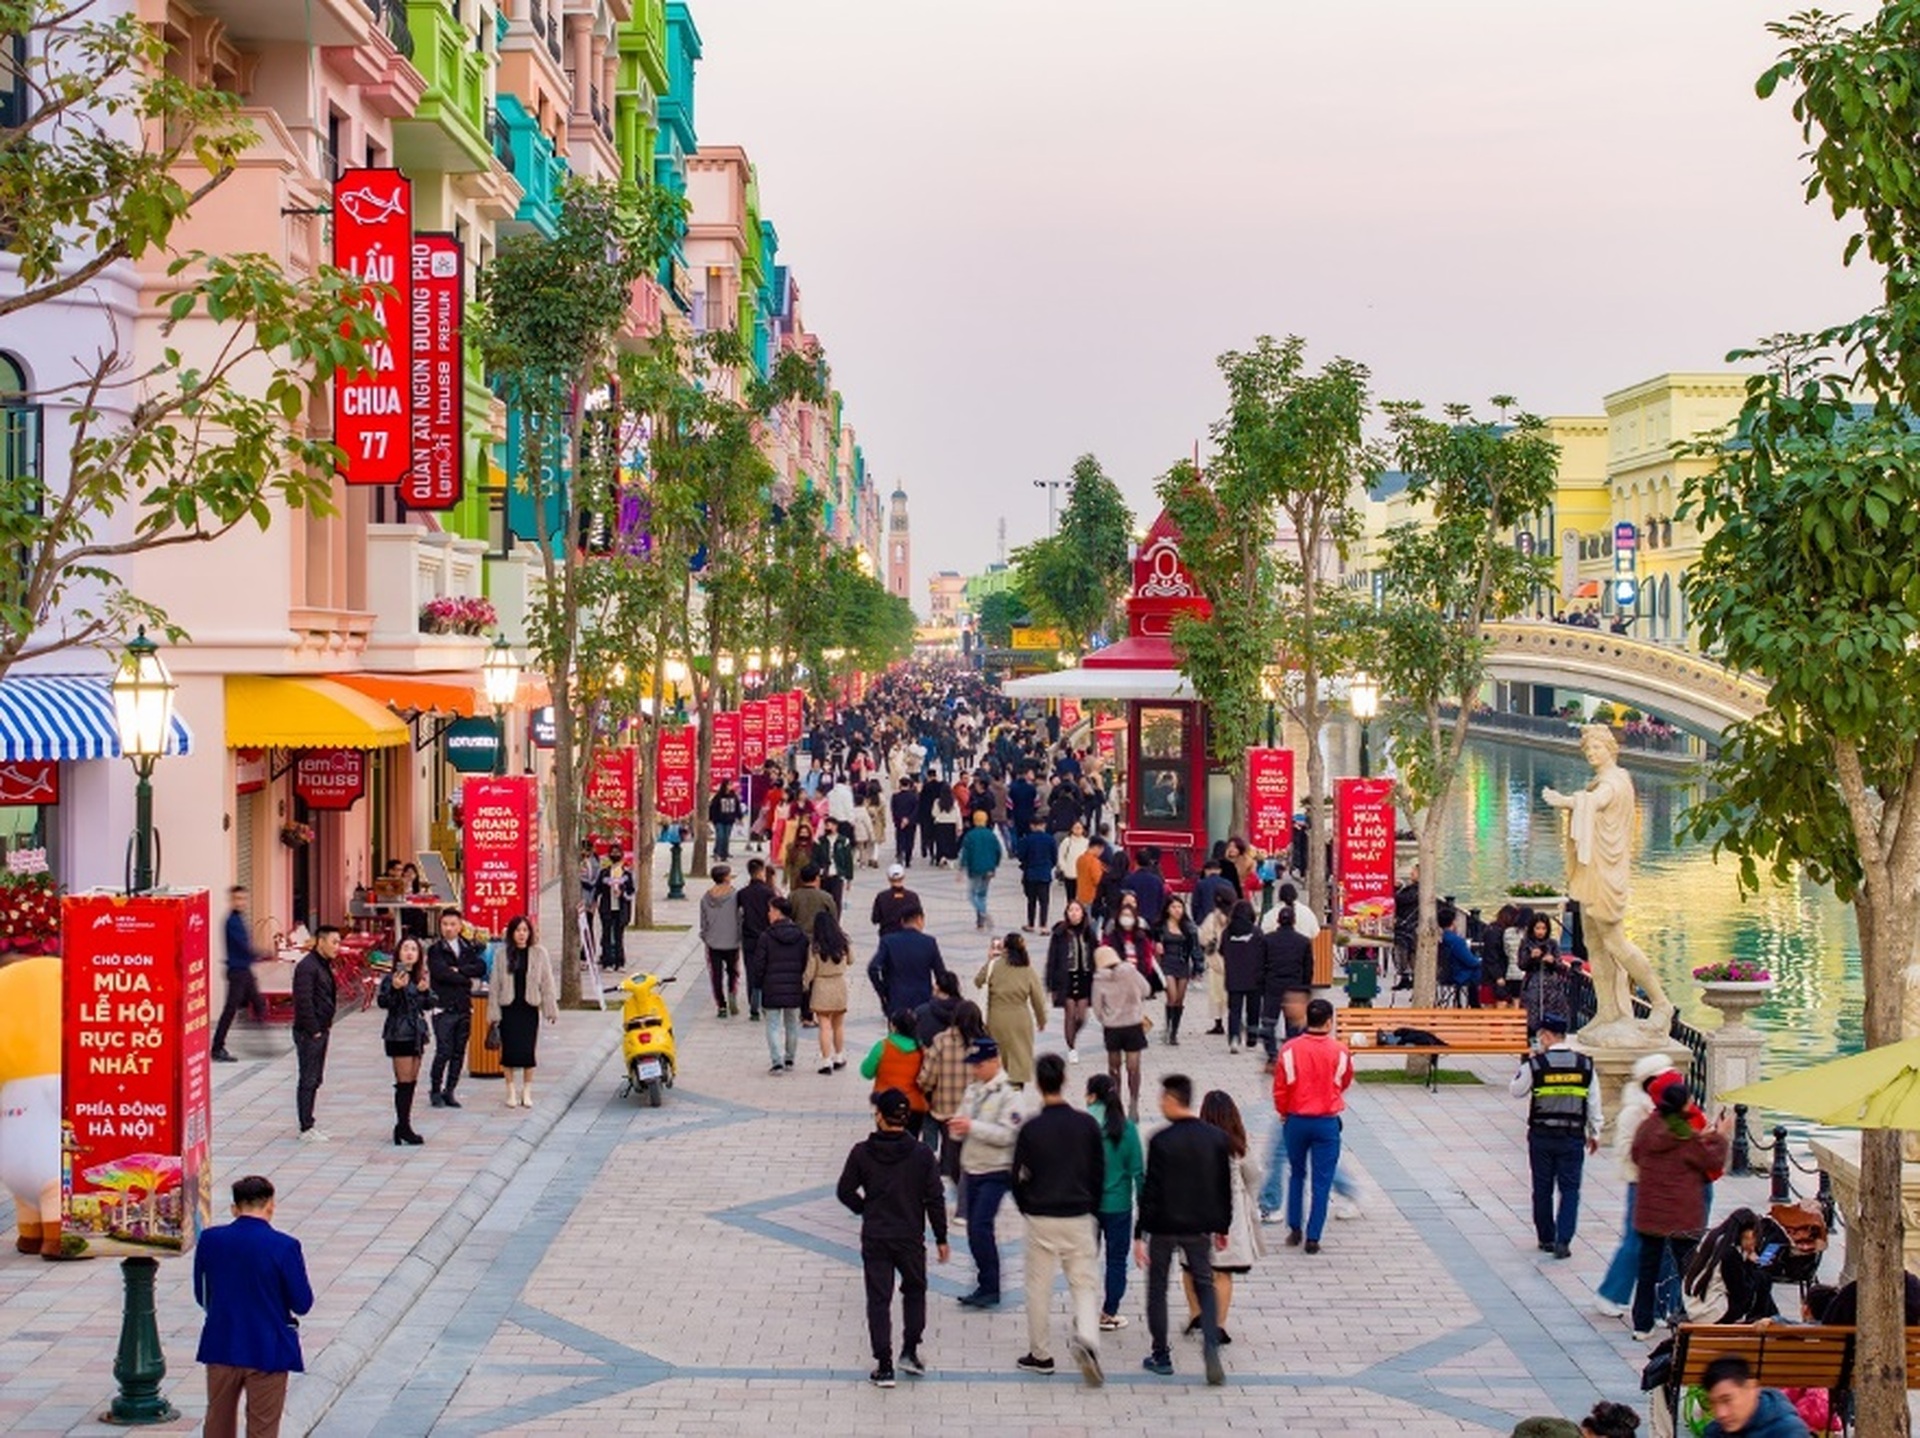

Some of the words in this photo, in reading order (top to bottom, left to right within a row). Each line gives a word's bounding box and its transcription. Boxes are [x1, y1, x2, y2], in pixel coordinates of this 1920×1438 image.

[412, 359, 431, 409] NGON
[343, 386, 402, 415] CHUA
[359, 431, 388, 459] 77
[298, 772, 359, 787] house
[478, 806, 513, 817] MEGA
[471, 818, 519, 830] GRAND
[472, 830, 519, 841] WORLD
[475, 882, 518, 897] 21.12
[93, 968, 151, 992] MÙA
[80, 993, 111, 1022] LỄ
[118, 998, 164, 1028] HỘI
[80, 1031, 126, 1052] RỰC
[131, 1027, 163, 1048] RỠ
[90, 1050, 153, 1075] NHẤT
[76, 1100, 115, 1116] PHÍA
[118, 1100, 167, 1117] ĐÔNG
[88, 1118, 116, 1136] HÀ
[120, 1118, 154, 1140] NỘI
